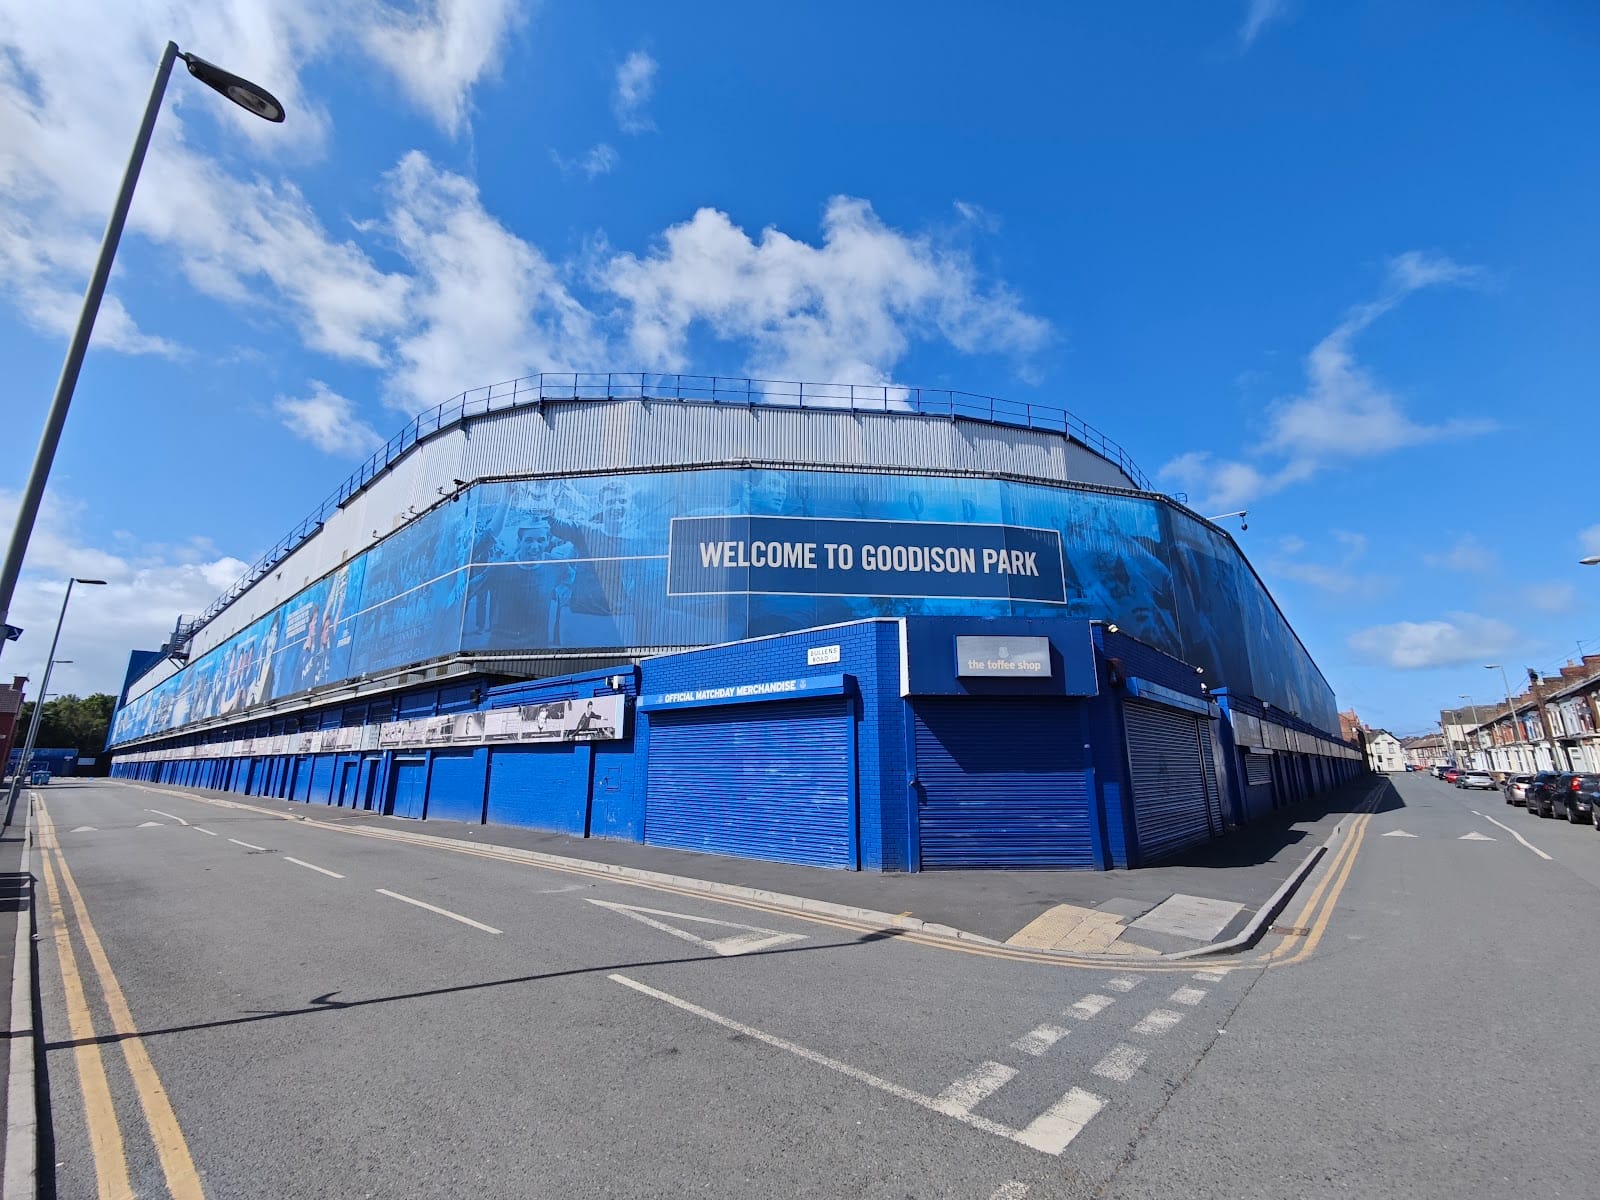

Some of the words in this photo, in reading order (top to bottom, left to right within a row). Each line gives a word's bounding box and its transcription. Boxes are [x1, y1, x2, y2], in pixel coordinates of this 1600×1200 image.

[700, 541, 818, 569] WELCOME
[823, 543, 854, 571] TO
[861, 544, 976, 573] GOODISON
[982, 548, 1040, 577] PARK
[810, 647, 838, 657] BULLENS
[967, 659, 985, 670] the
[987, 659, 1016, 670] toffee
[1017, 660, 1041, 672] shop
[664, 691, 695, 703] OFFICIAL
[695, 686, 736, 700] MATCHDAY
[736, 680, 797, 697] MERCHANDISE
